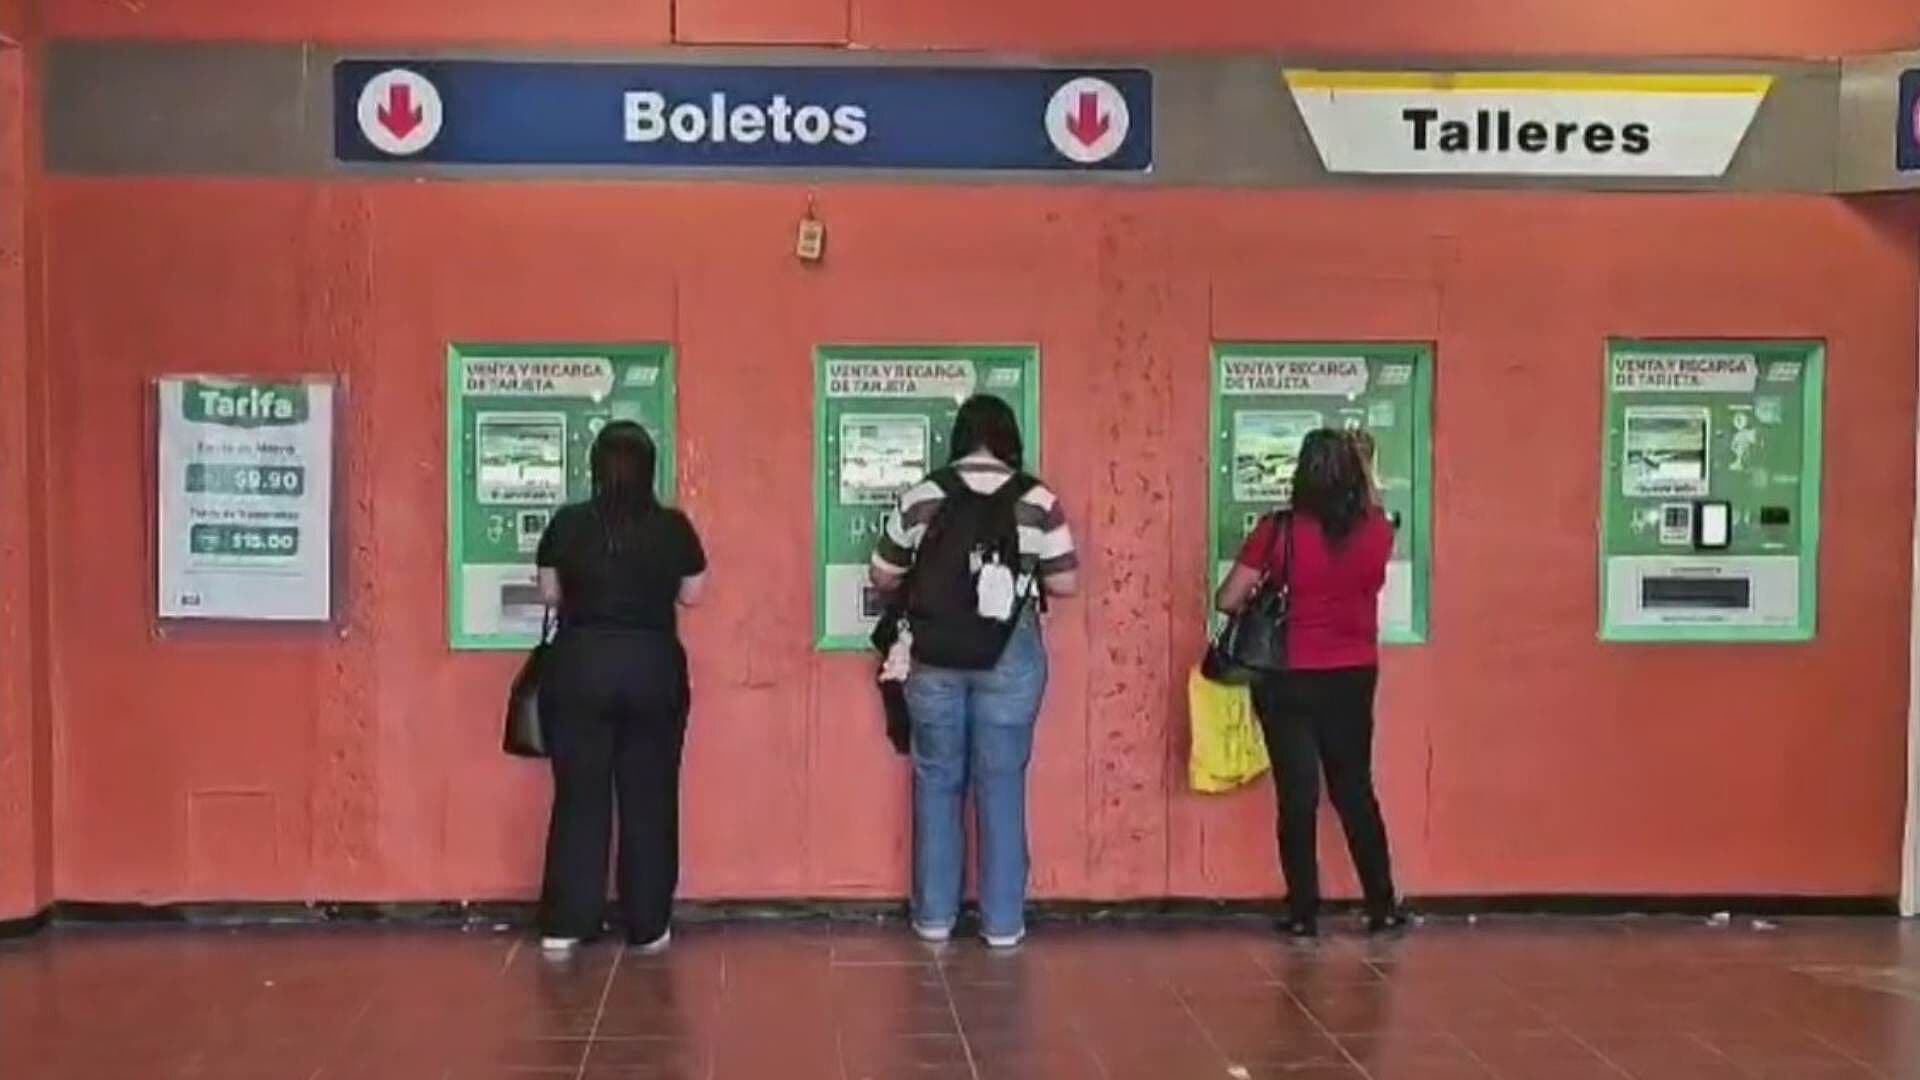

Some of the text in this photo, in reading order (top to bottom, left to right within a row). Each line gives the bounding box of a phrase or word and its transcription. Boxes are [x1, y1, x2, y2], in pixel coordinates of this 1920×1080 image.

[624, 91, 868, 144] Boletos
[1402, 108, 1651, 155] Talleres
[198, 388, 293, 418] Tarifa
[232, 532, 293, 550] $15.00
